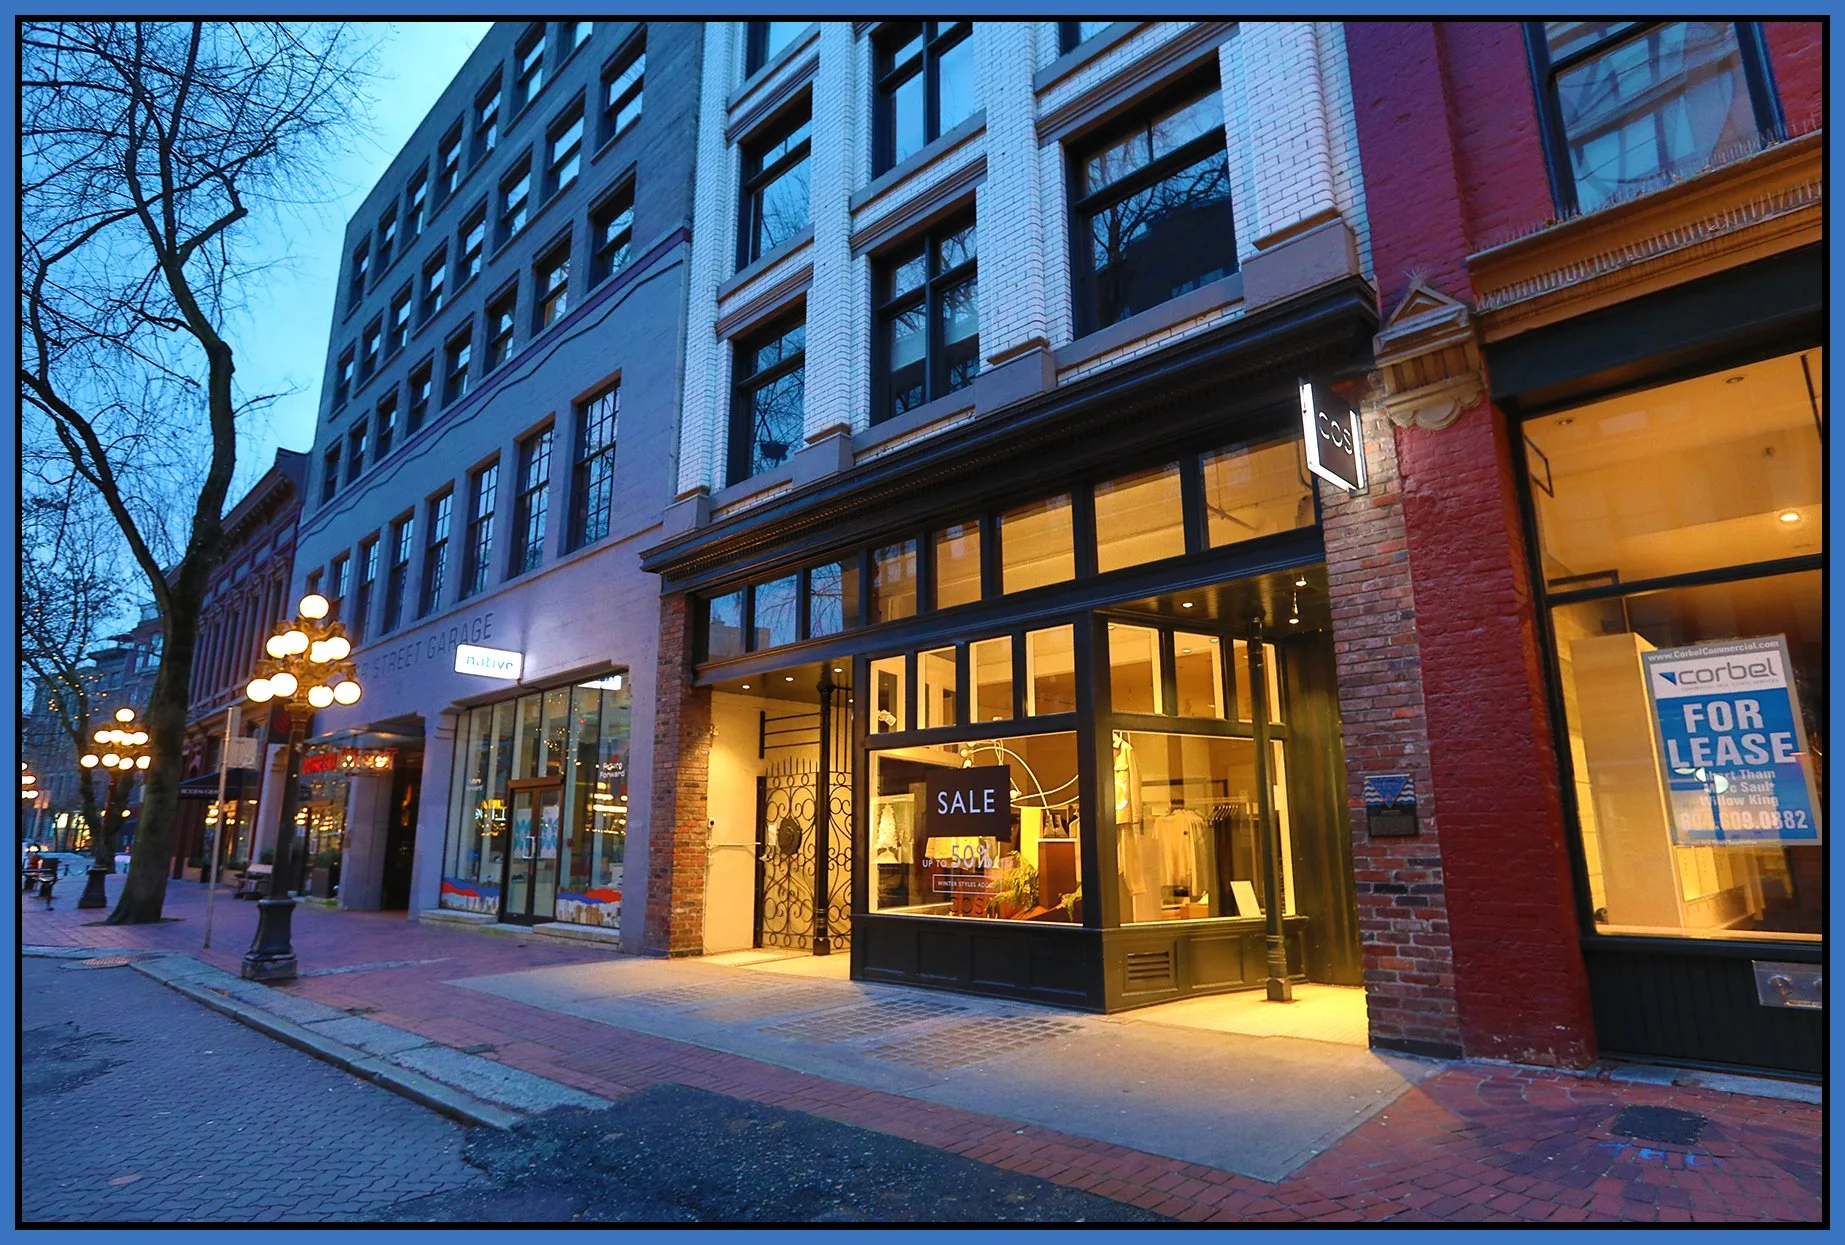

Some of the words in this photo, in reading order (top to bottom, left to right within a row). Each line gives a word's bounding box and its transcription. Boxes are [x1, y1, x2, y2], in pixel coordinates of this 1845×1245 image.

[1318, 410, 1353, 456] COS
[373, 641, 423, 680] STREET
[427, 612, 494, 660] GARAGE
[1647, 640, 1780, 663] www.CorbelCommercial.com
[1678, 657, 1778, 686] corbel
[1682, 698, 1764, 734] FOR
[1667, 731, 1797, 769] LEASE
[1739, 769, 1776, 780] Tham
[1703, 782, 1738, 794] Mc
[937, 789, 996, 814] SALE
[1748, 794, 1779, 808] King
[922, 859, 934, 868] UP
[936, 859, 947, 868] TO
[951, 844, 993, 869] 50%
[937, 880, 958, 888] WINTER
[948, 896, 985, 915] COS
